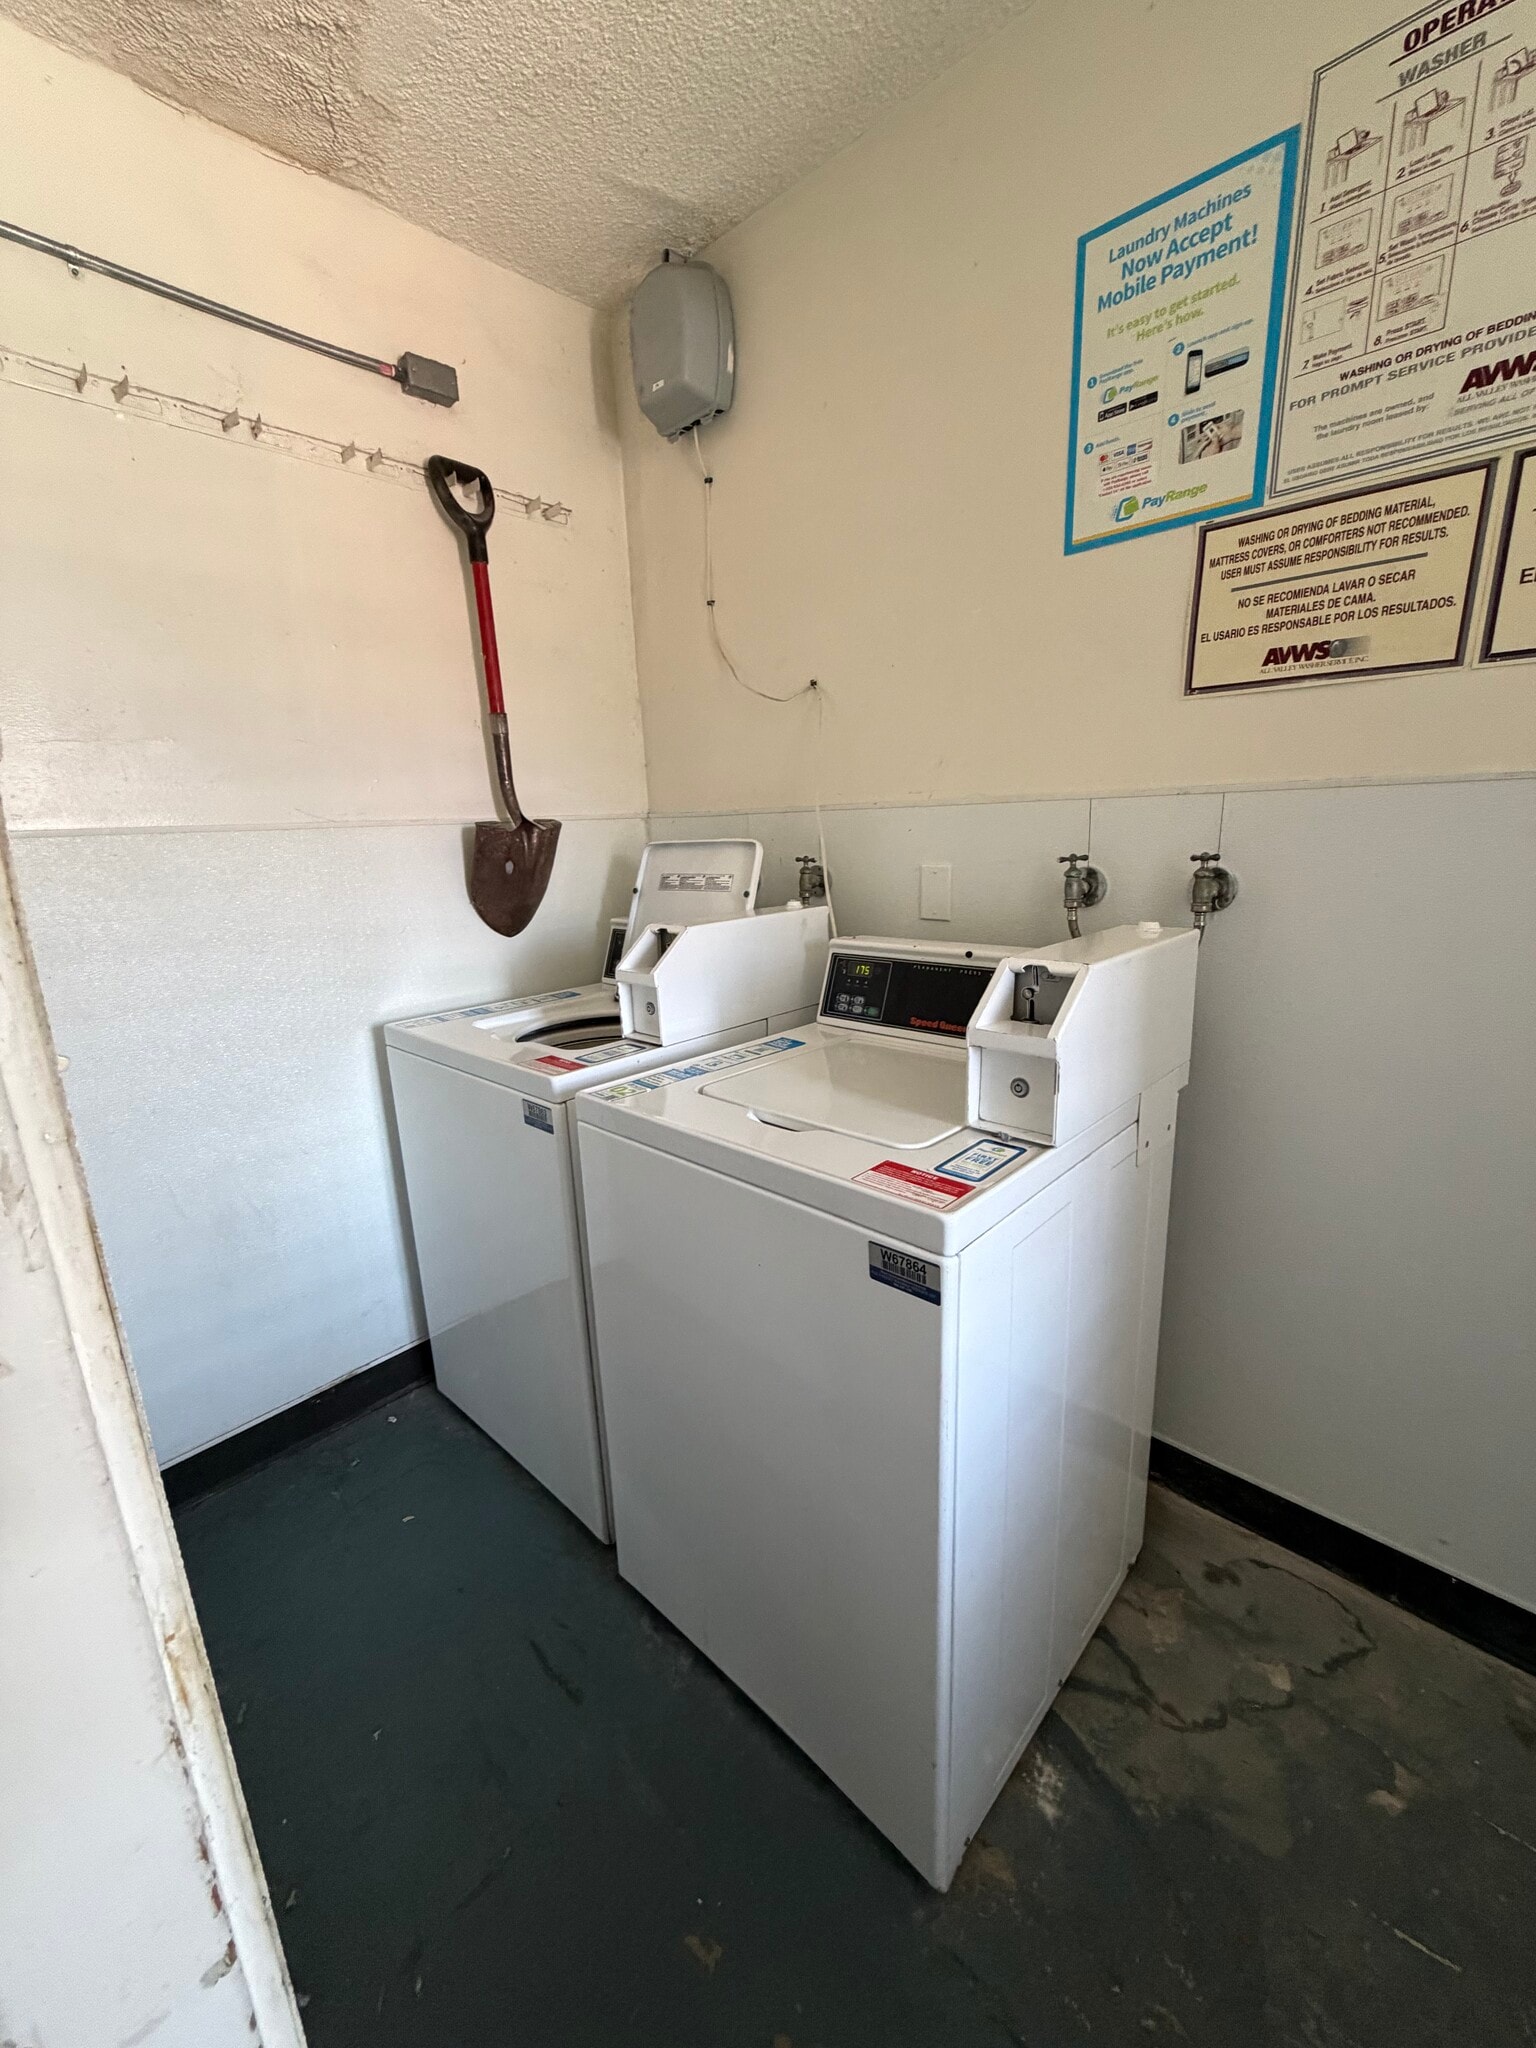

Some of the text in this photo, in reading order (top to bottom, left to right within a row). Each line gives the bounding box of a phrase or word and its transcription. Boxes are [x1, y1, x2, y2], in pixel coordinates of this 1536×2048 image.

[1404, 0, 1500, 52] OPERA
[1398, 31, 1487, 87] WASHER
[1109, 184, 1252, 263] Laundry Machines
[1121, 212, 1233, 280] Now Accept
[1098, 275, 1156, 313] Mobile
[1161, 224, 1258, 284] Payment!
[1107, 273, 1240, 338] It's easy to get started.
[1136, 307, 1205, 341] Here's how.
[1340, 358, 1392, 381] WASHING
[1395, 352, 1412, 364] OR
[1416, 335, 1462, 358] DRYING
[1465, 327, 1485, 342] OF
[1119, 376, 1159, 394] PayRange
[1290, 396, 1316, 411] FOR
[1321, 374, 1382, 401] PROMPT
[1387, 352, 1456, 380] SERVICE
[1313, 424, 1327, 432] The
[1330, 413, 1367, 429] machines
[1418, 392, 1435, 403] and
[1330, 423, 1360, 436] laundry
[1362, 417, 1384, 427] room
[1142, 484, 1208, 509] PayRange
[1209, 505, 1470, 568] MATTRESS COVERS, OR COMFORTERS NOT RECOMMENDED.
[1238, 496, 1435, 547] WASHING OR DRYING OF BEDDING MATERIAL,
[1221, 526, 1448, 580] USER MUST ASSUME RESPONSIBILITY FOR RESULTS.
[1238, 569, 1416, 609] NO SE RECOMIENDA LAVAR O SECAR
[1520, 567, 1536, 584] E
[1201, 596, 1456, 643] EL USARIO ES RESPONSABLE POR LOS RESULTADOS.
[1266, 592, 1376, 618] MATERIALES DE CAMA.
[1261, 640, 1332, 667] AVWS
[856, 965, 870, 975] 175
[910, 1017, 938, 1028] Speed
[880, 1248, 927, 1275] W67864
